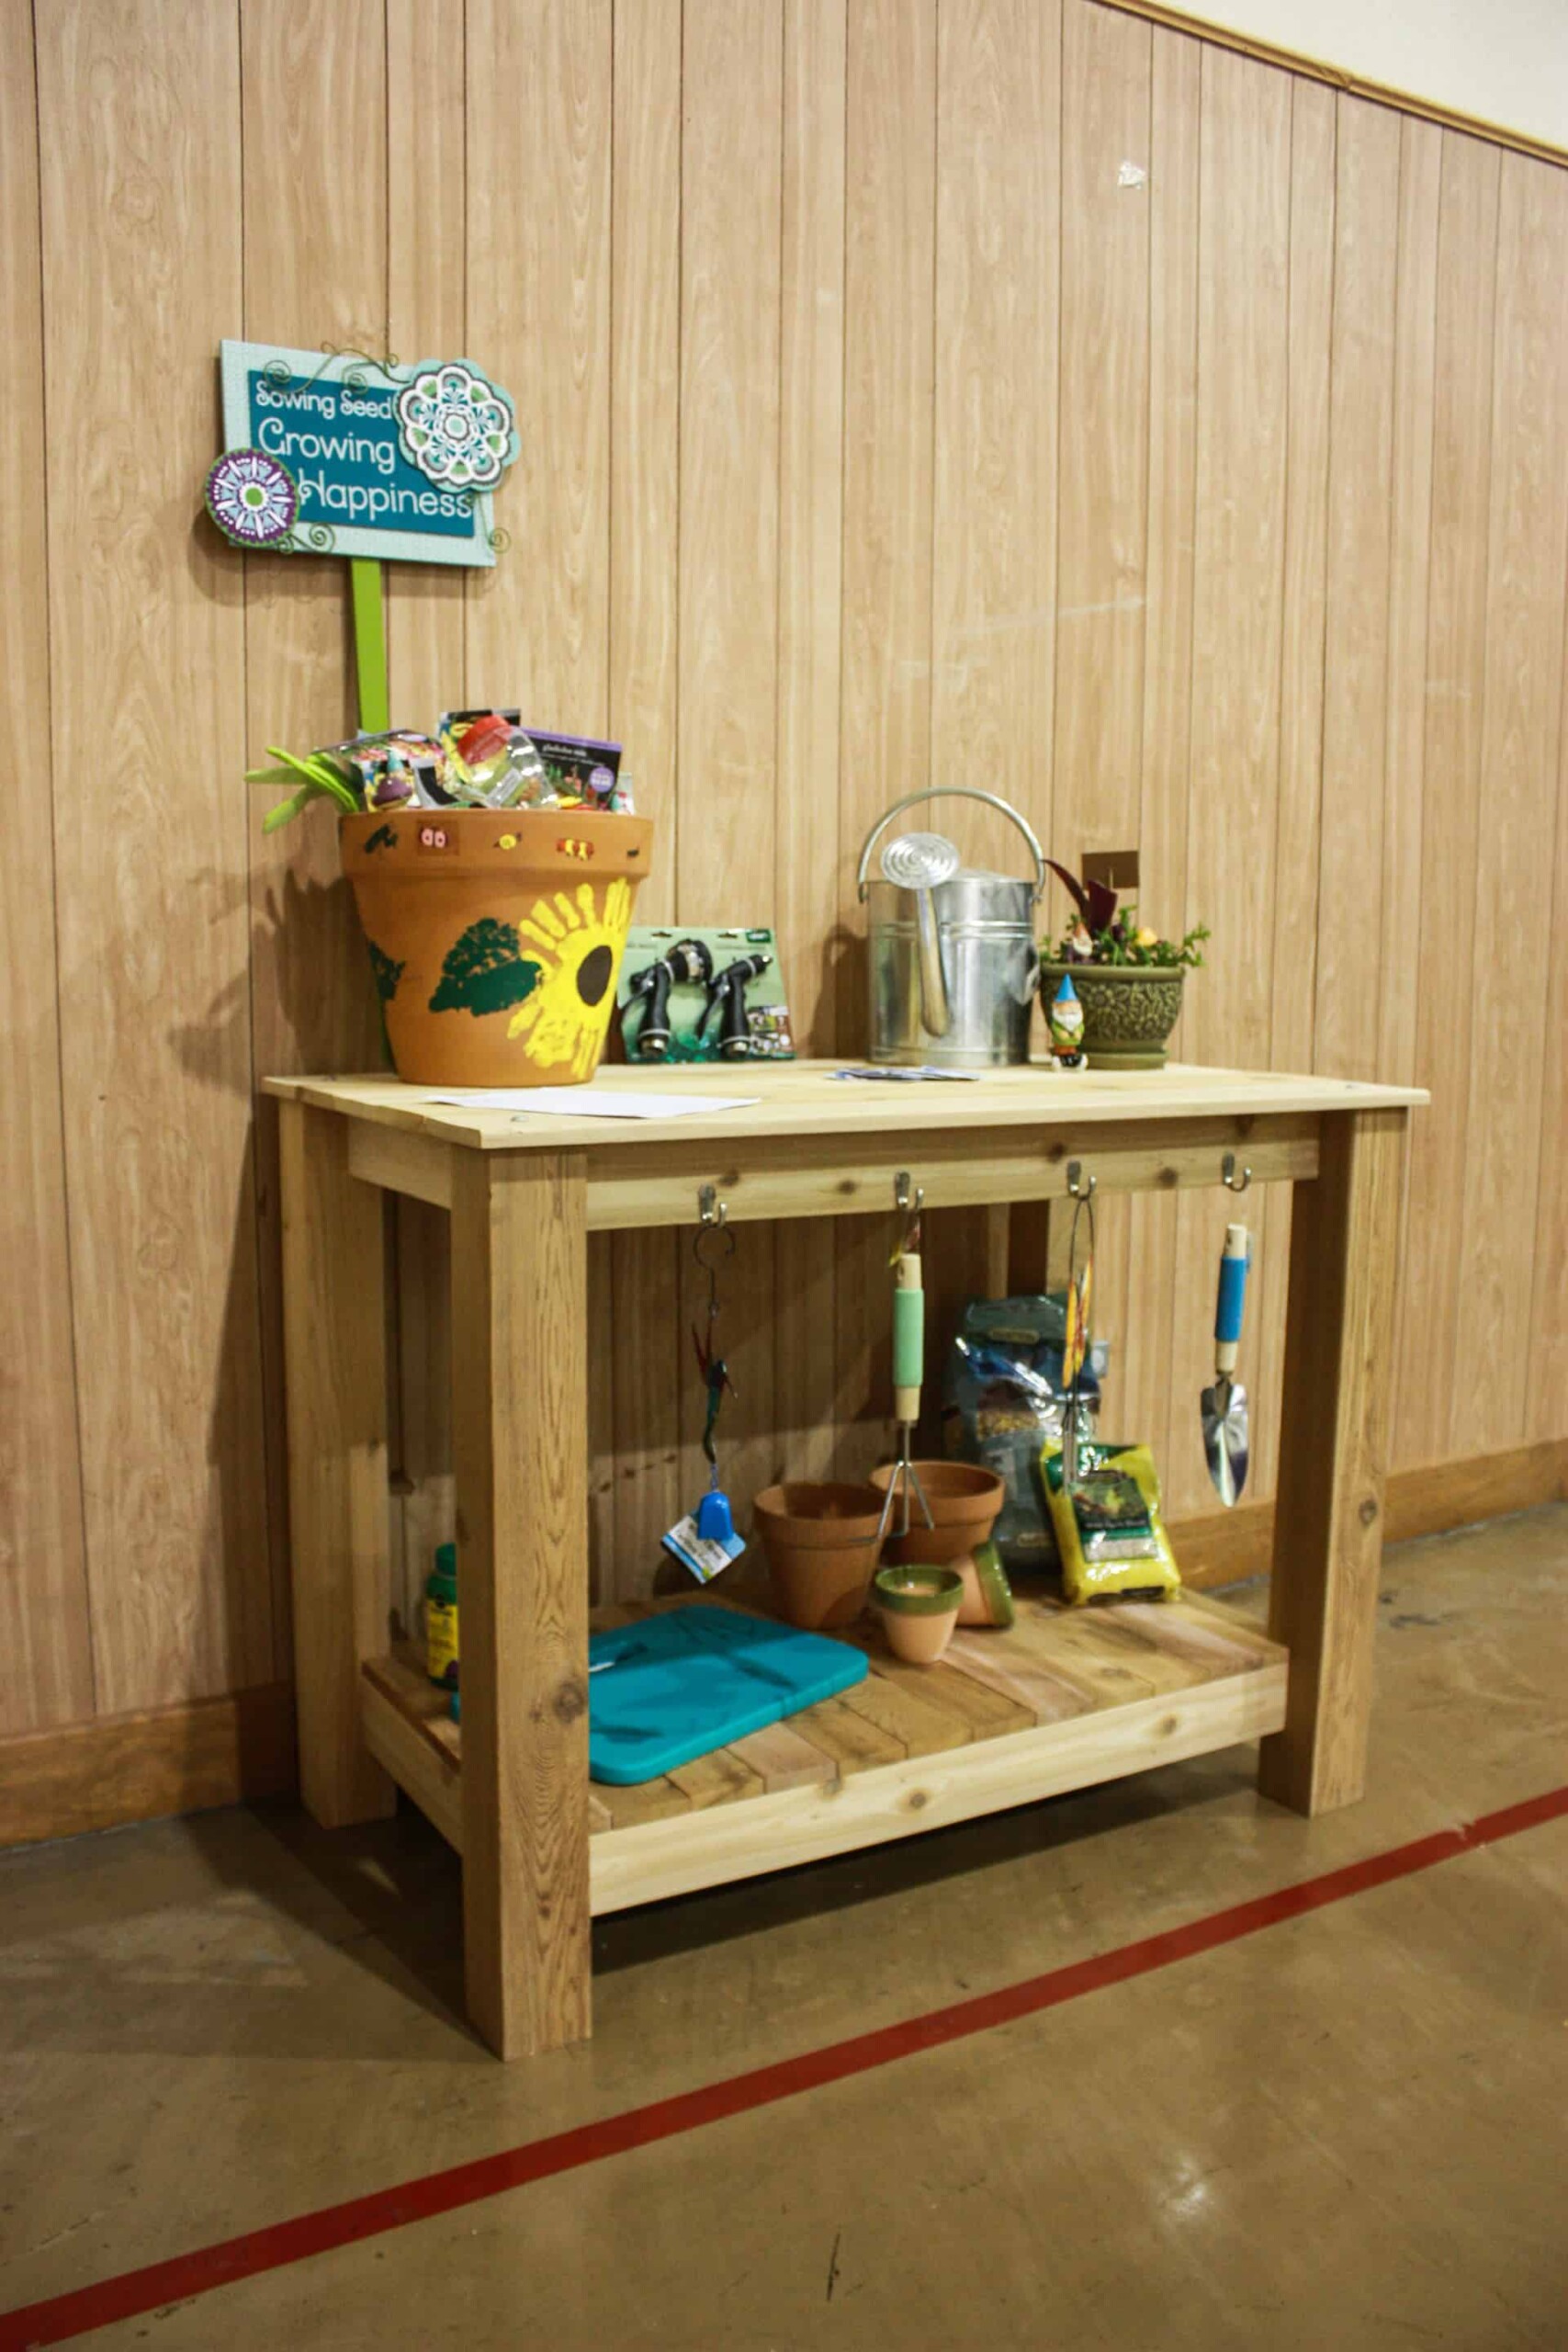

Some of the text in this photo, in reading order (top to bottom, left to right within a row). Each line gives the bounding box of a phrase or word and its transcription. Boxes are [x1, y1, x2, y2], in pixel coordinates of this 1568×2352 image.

[255, 379, 335, 420] Sowing
[258, 417, 395, 474] Growing
[298, 468, 472, 521] Happiness
